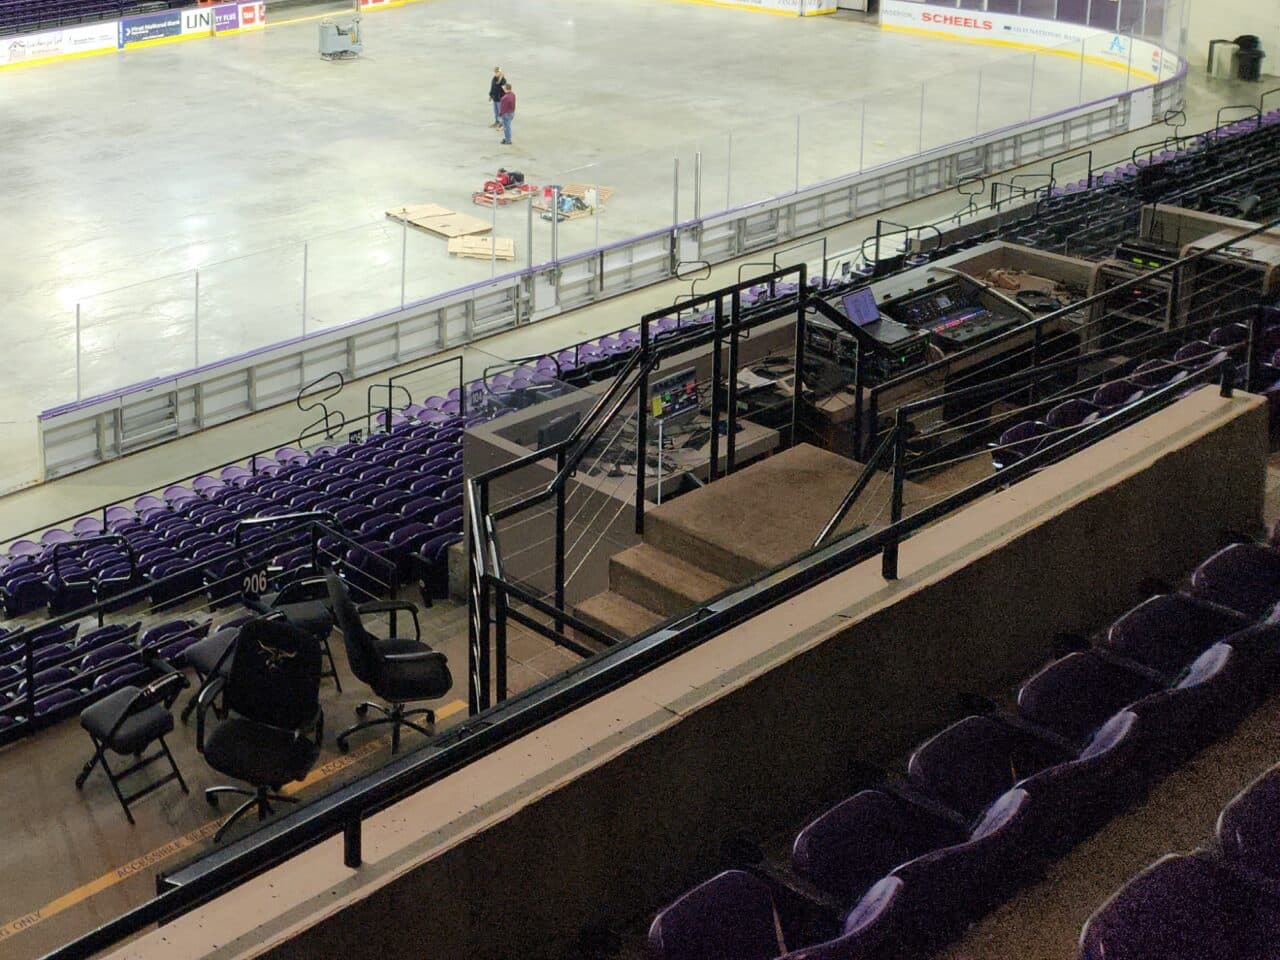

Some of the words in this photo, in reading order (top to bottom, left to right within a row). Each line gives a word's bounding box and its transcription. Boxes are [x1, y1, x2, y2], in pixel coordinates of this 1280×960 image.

[922, 12, 992, 30] SCHEELS
[243, 570, 266, 592] 206
[13, 911, 41, 931] ONLY
